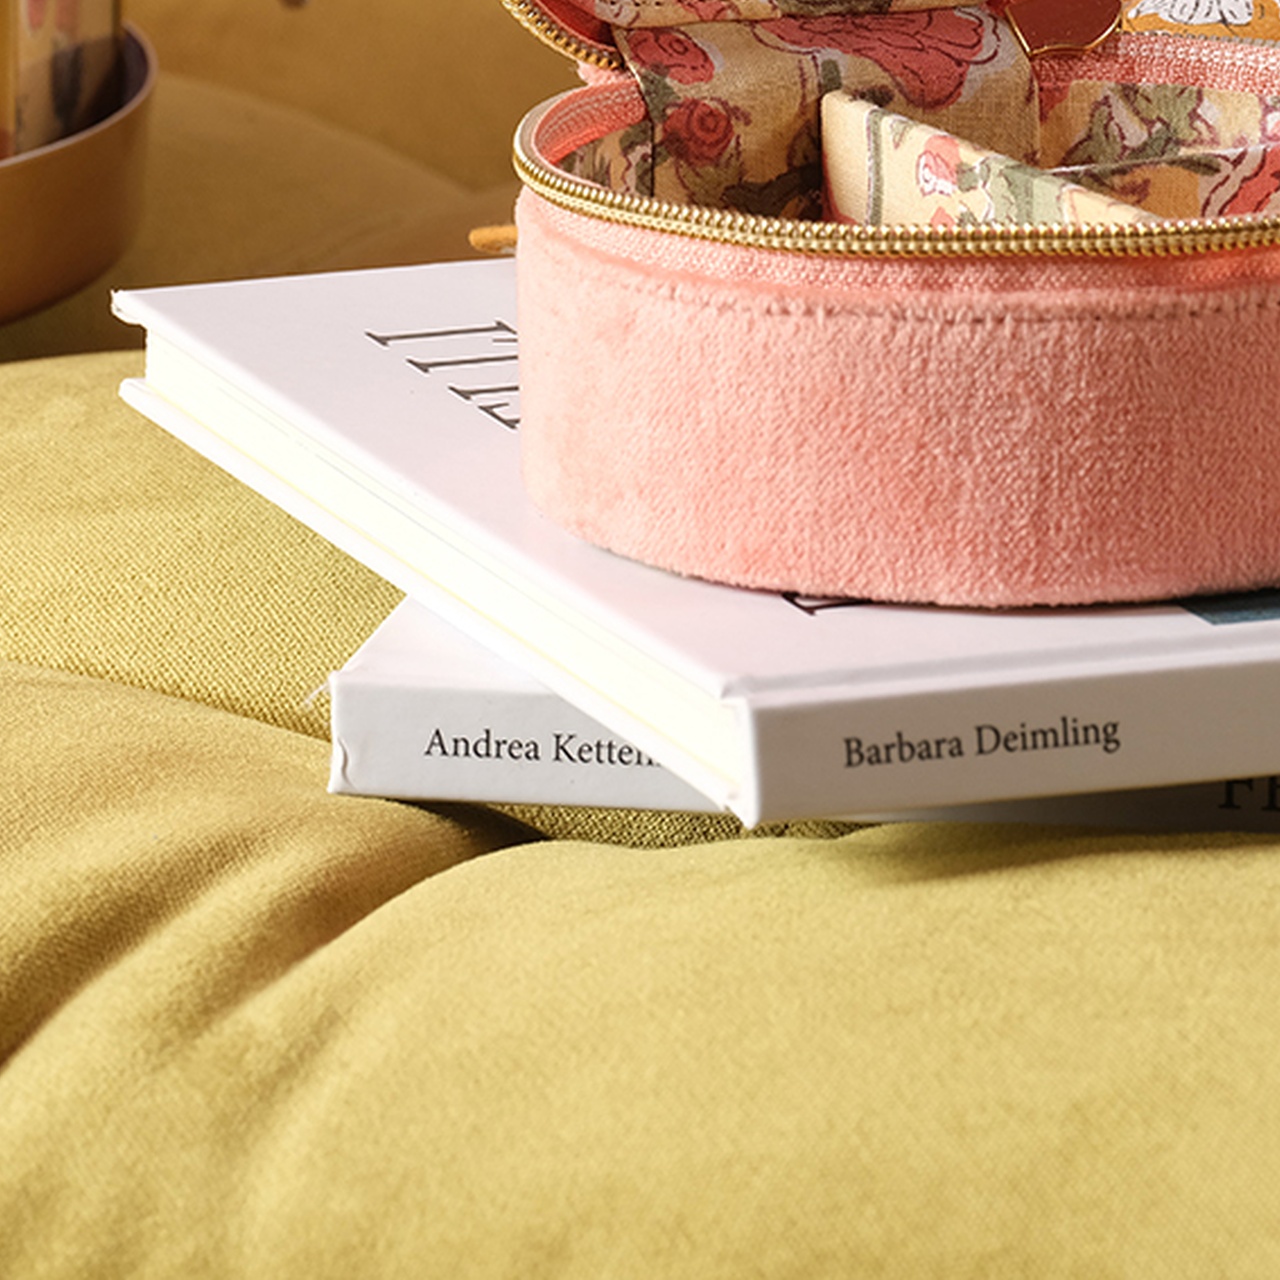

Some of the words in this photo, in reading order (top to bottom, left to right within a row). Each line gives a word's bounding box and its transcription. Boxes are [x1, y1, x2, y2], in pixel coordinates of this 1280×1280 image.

[424, 728, 541, 761] Andrea
[844, 731, 964, 768] Barbara
[975, 715, 1121, 754] Deimling
